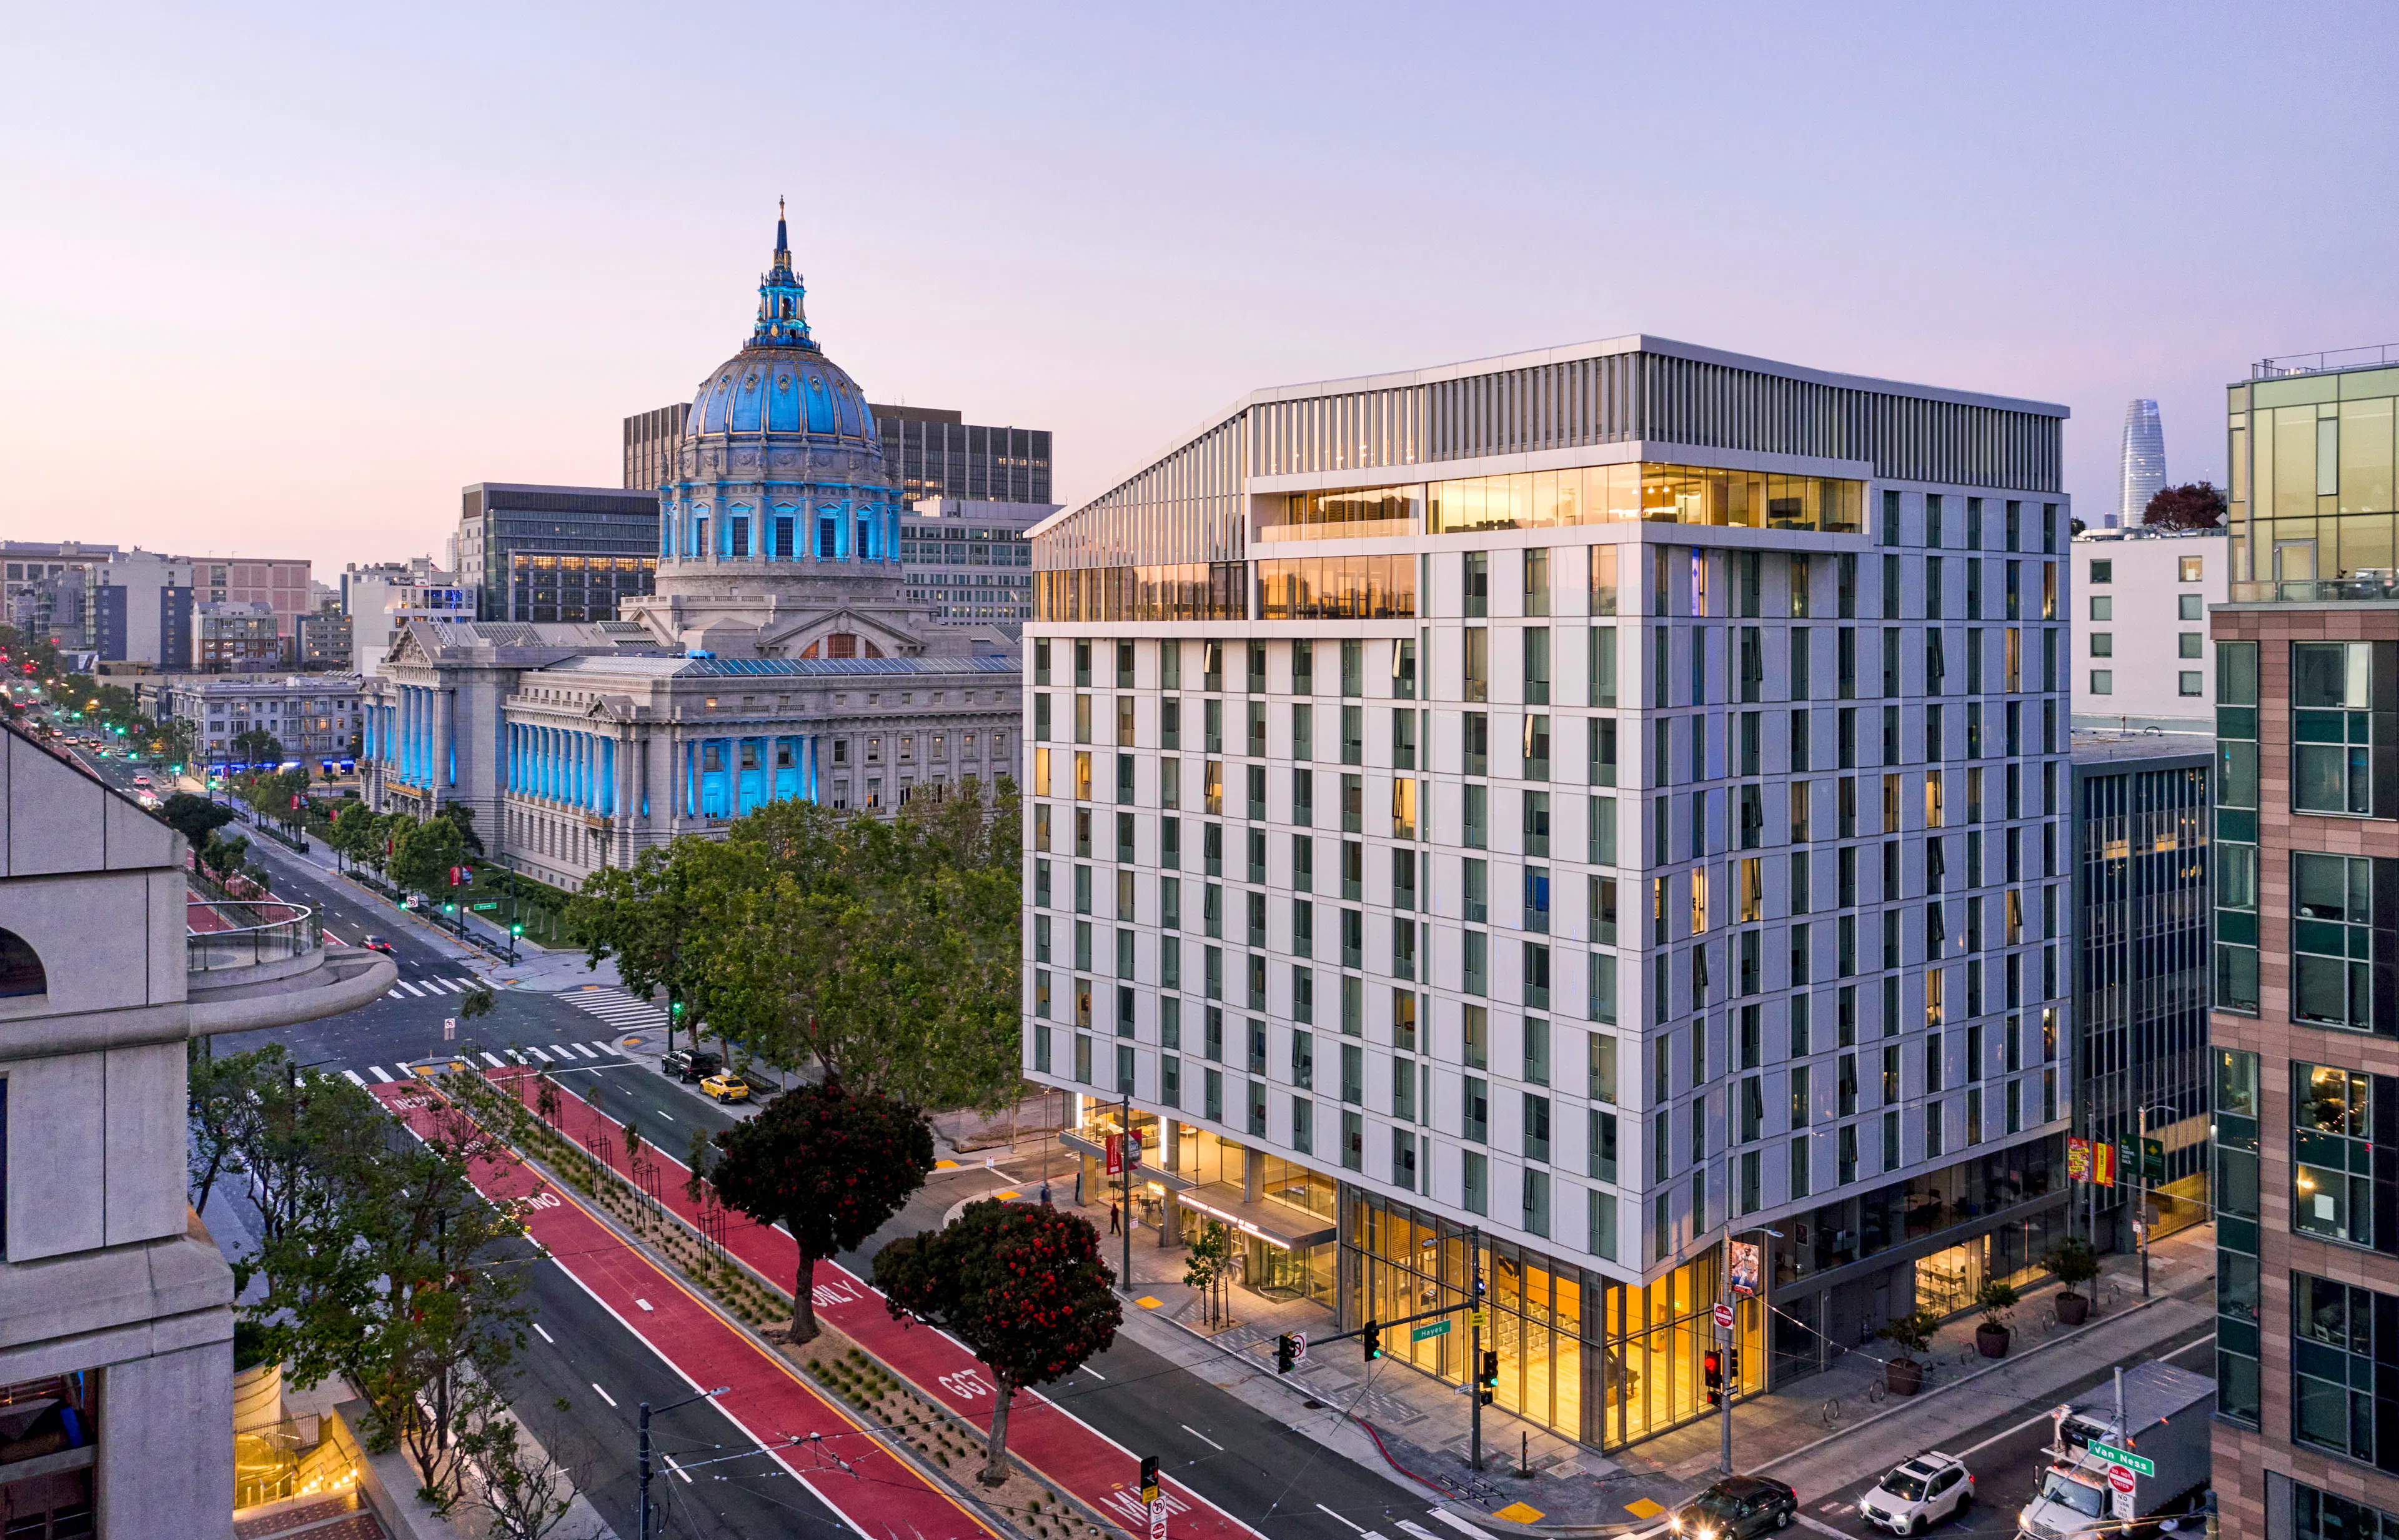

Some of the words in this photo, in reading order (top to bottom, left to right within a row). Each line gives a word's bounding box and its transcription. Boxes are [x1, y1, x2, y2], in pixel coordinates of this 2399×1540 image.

[1421, 1325, 1443, 1338] Hayes
[938, 1368, 998, 1399] GGT
[2094, 1446, 2115, 1459] Van
[2120, 1453, 2147, 1471] Ness
[2113, 1479, 2129, 1489] ENTER
[2117, 1493, 2128, 1501] NO
[2117, 1499, 2129, 1508] TURN
